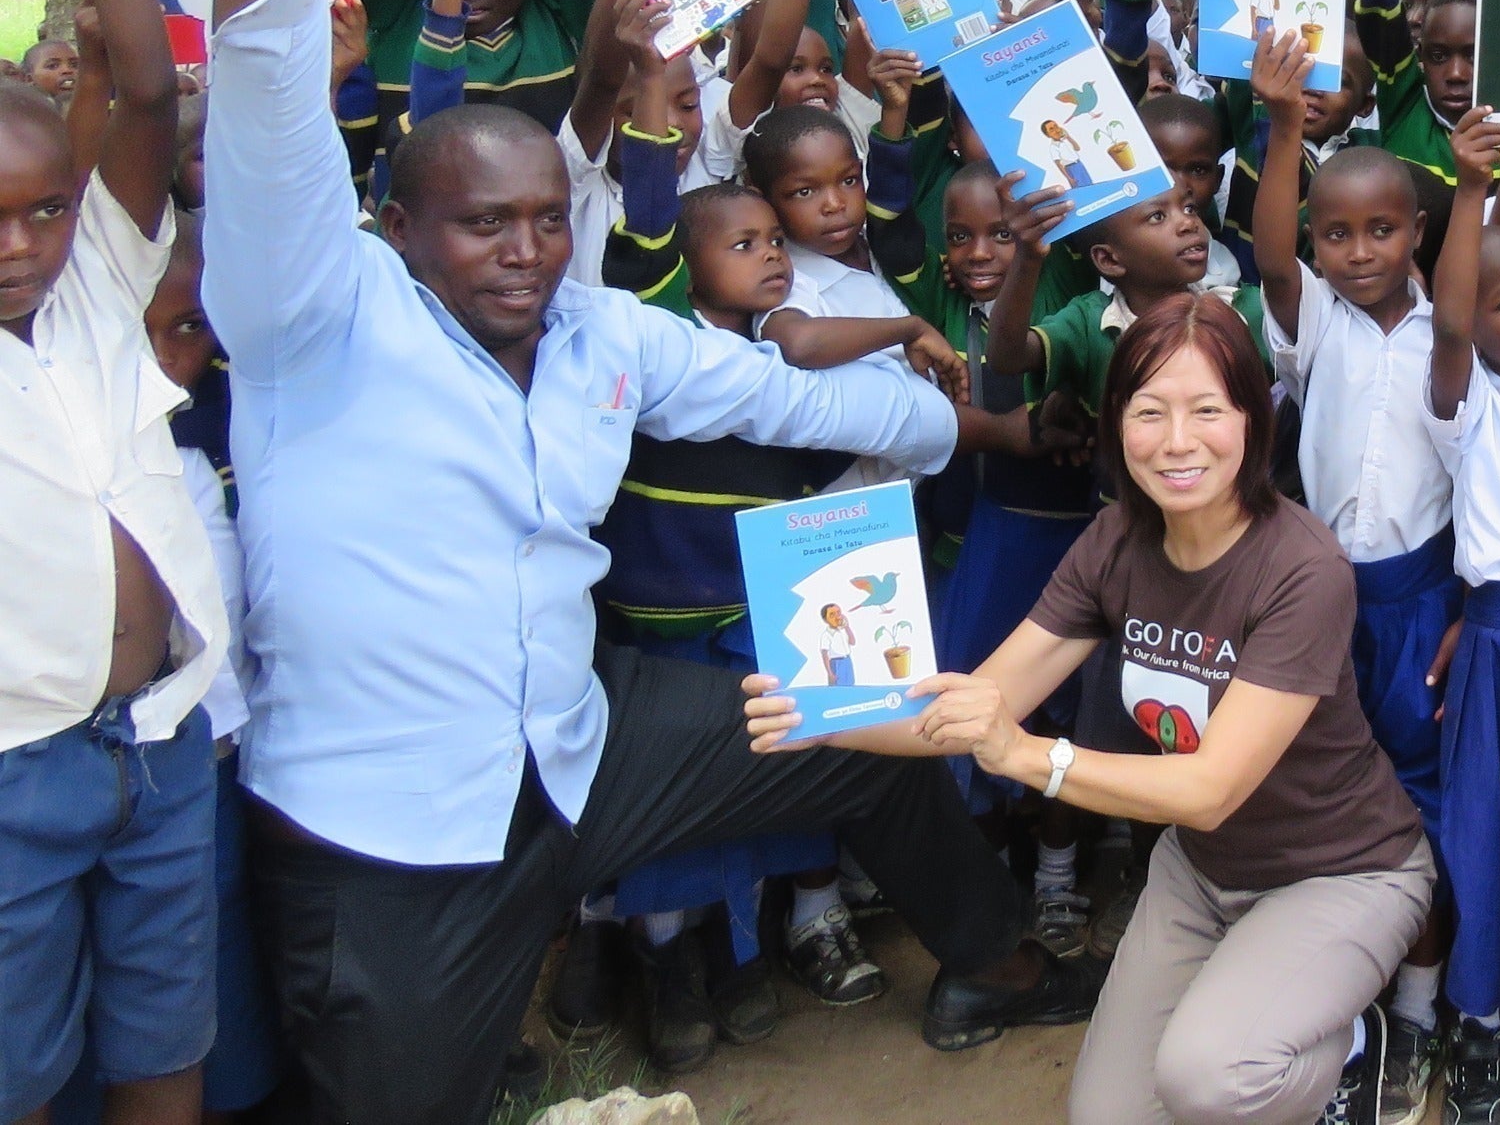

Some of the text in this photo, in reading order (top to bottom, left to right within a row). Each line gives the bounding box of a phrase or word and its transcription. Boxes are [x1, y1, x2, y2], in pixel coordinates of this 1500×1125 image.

[981, 26, 1048, 67] Sayansi
[787, 500, 869, 530] Sayansi
[781, 520, 890, 547] Kitabu cha Mwanafunzi
[803, 545, 833, 556] Darasa
[846, 539, 864, 549] Tatu
[1124, 618, 1164, 647] GO
[1133, 647, 1230, 680] Our future from Africa
